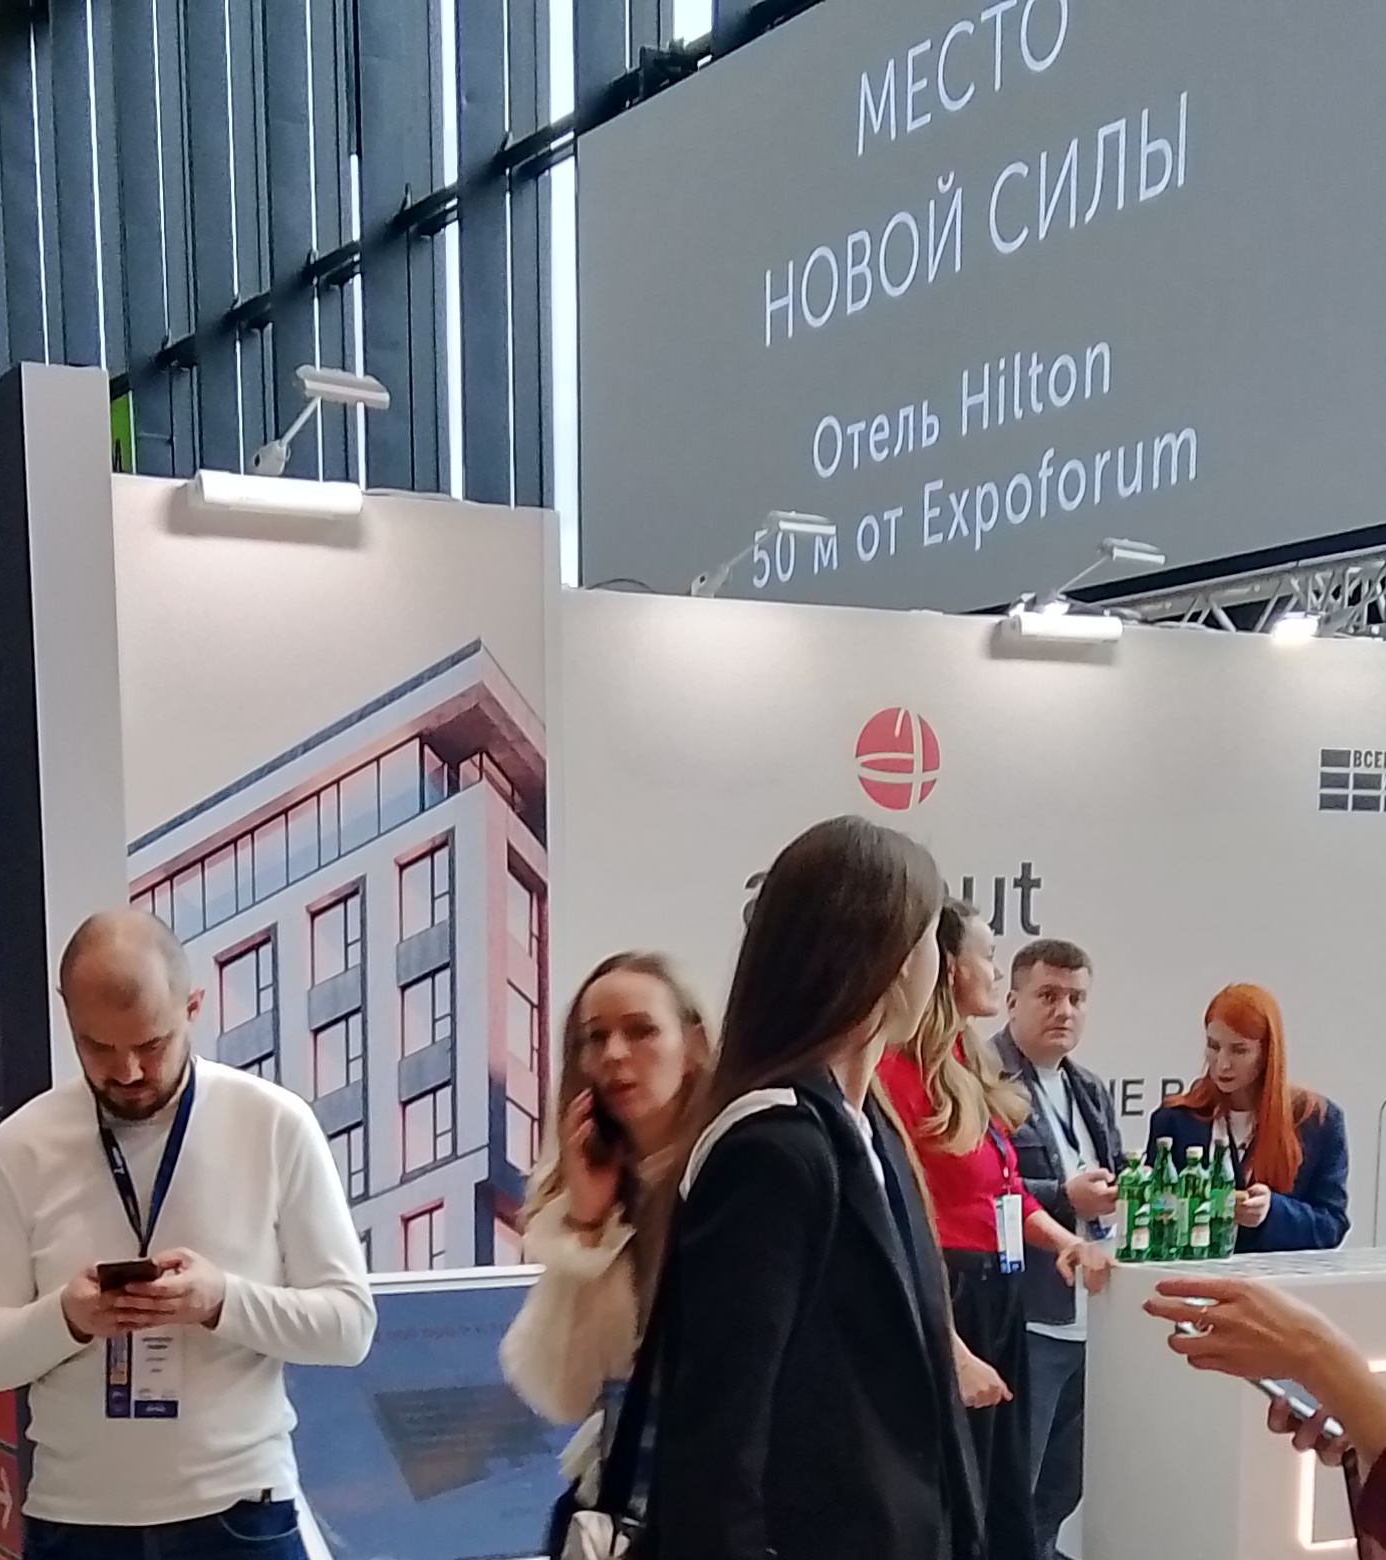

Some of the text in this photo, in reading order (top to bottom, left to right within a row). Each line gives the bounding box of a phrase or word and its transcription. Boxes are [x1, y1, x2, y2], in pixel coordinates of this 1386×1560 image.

[857, 0, 1069, 156] МЕСТО
[765, 91, 1188, 347] НОВОЙ СИЛЫ
[813, 341, 1110, 478] Отель Hilton
[752, 528, 795, 588] 50
[856, 507, 903, 562] от
[923, 427, 1198, 550] Expoforum
